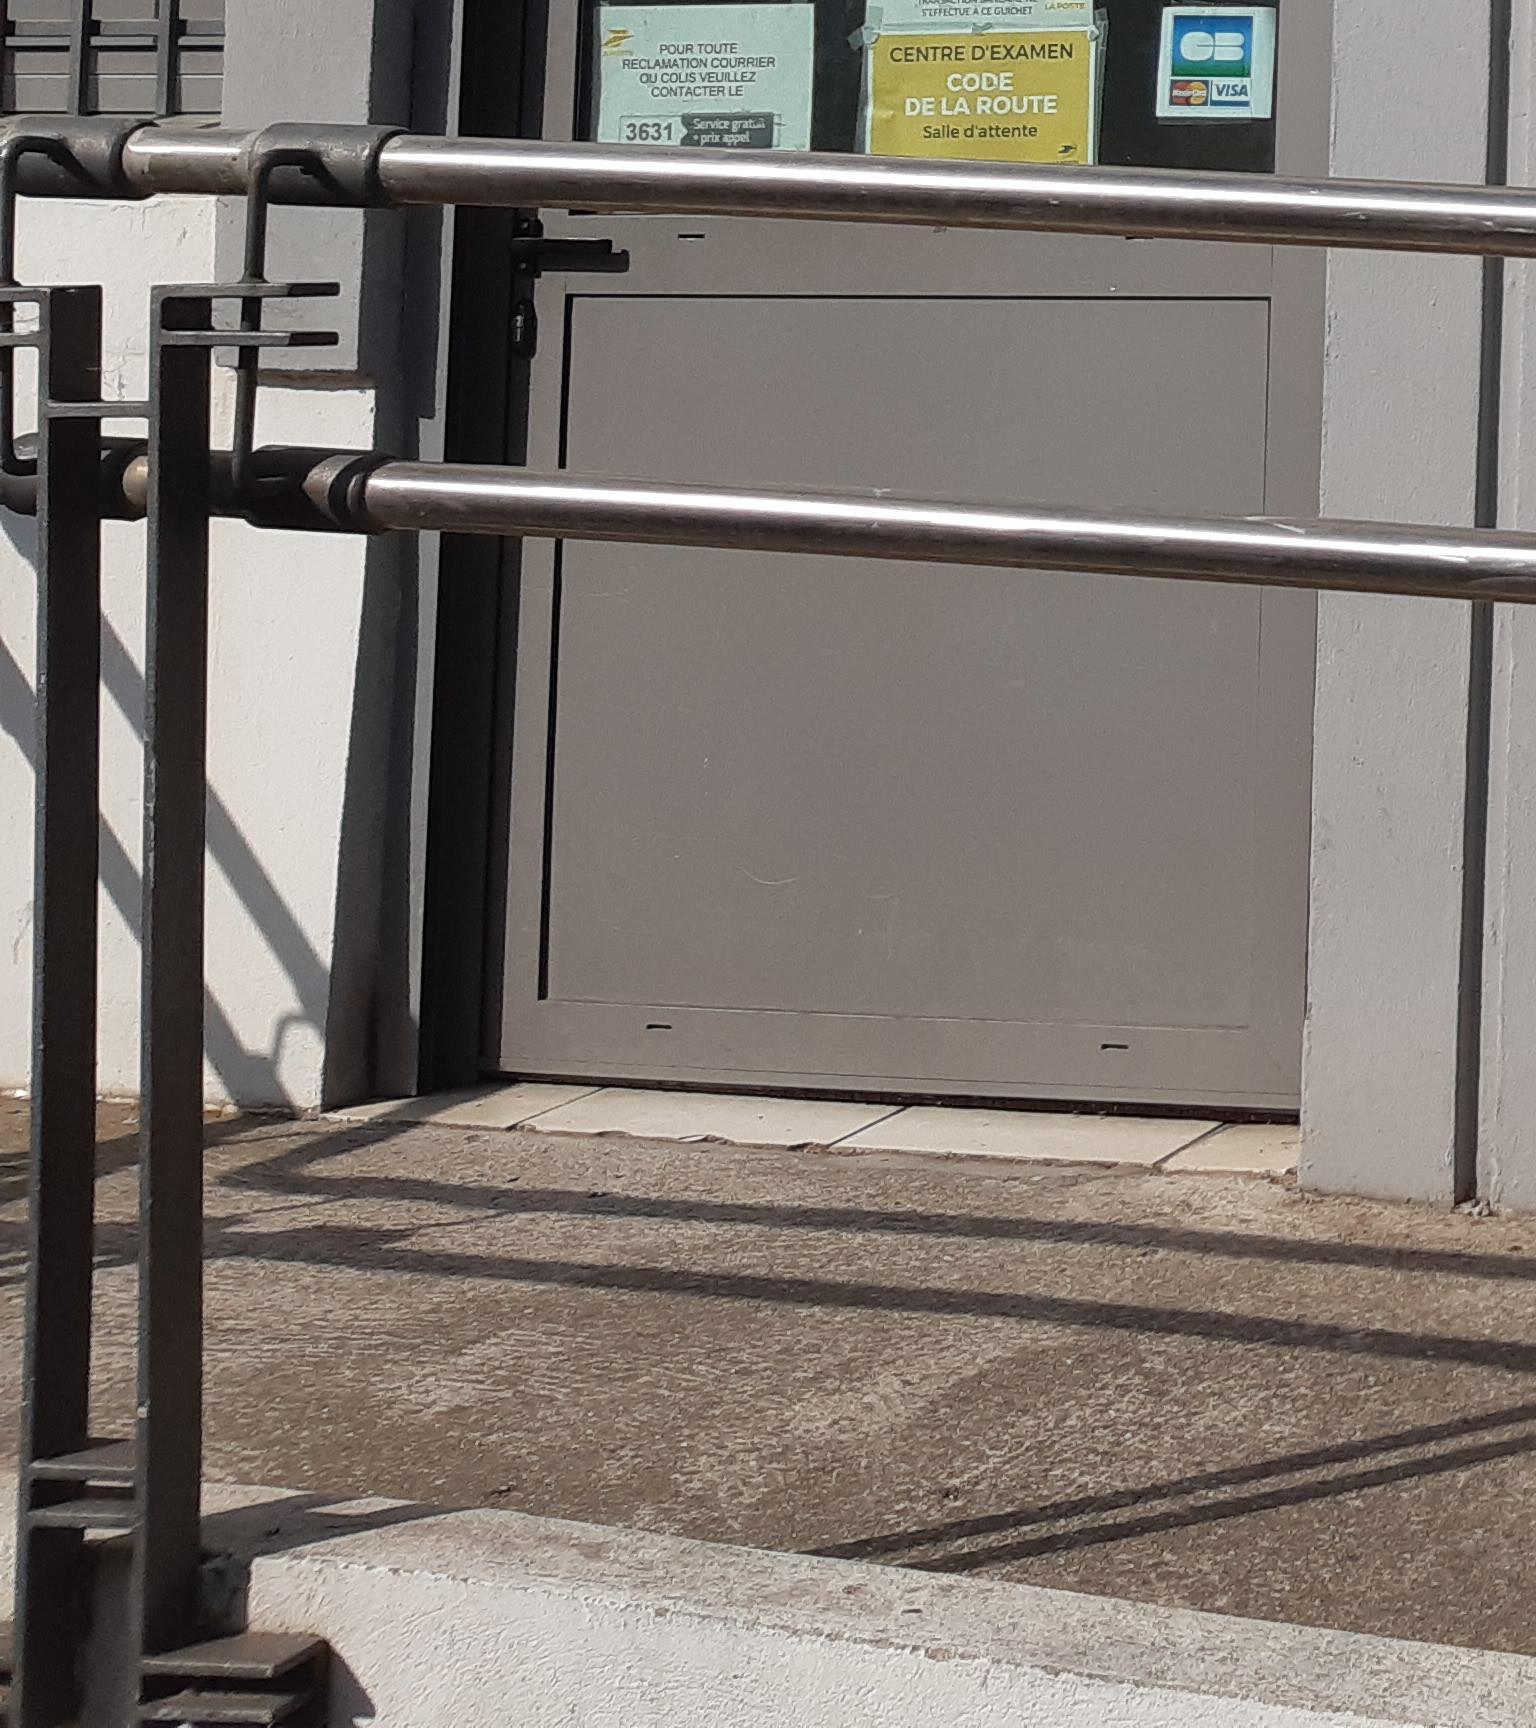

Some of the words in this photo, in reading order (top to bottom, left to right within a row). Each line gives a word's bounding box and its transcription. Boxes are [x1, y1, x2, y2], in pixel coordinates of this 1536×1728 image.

[981, 7, 992, 16] CE
[994, 6, 1033, 15] GUICHET
[659, 43, 696, 55] POUR
[698, 42, 738, 54] TOUTE
[890, 46, 966, 62] CENTRE
[972, 43, 1073, 60] D'EXAMEN
[1180, 31, 1245, 61] CB
[622, 58, 708, 70] RECLAMATION
[711, 57, 776, 69] COURRIER
[640, 72, 657, 84] OU
[661, 72, 697, 84] COLIS
[700, 71, 757, 83] VEUILLEZ
[946, 72, 1014, 92] CODE
[651, 86, 725, 98] CONTACTER
[729, 85, 744, 97] LE
[1214, 83, 1249, 97] VISA
[905, 97, 935, 116] DE
[941, 96, 970, 115] LA
[976, 95, 1058, 115] ROUTE
[693, 118, 730, 129] Service
[625, 122, 673, 142] 3631
[923, 125, 960, 138] Salle
[964, 124, 1038, 138] d'attente
[701, 132, 720, 146] prix
[722, 131, 750, 146] appel
